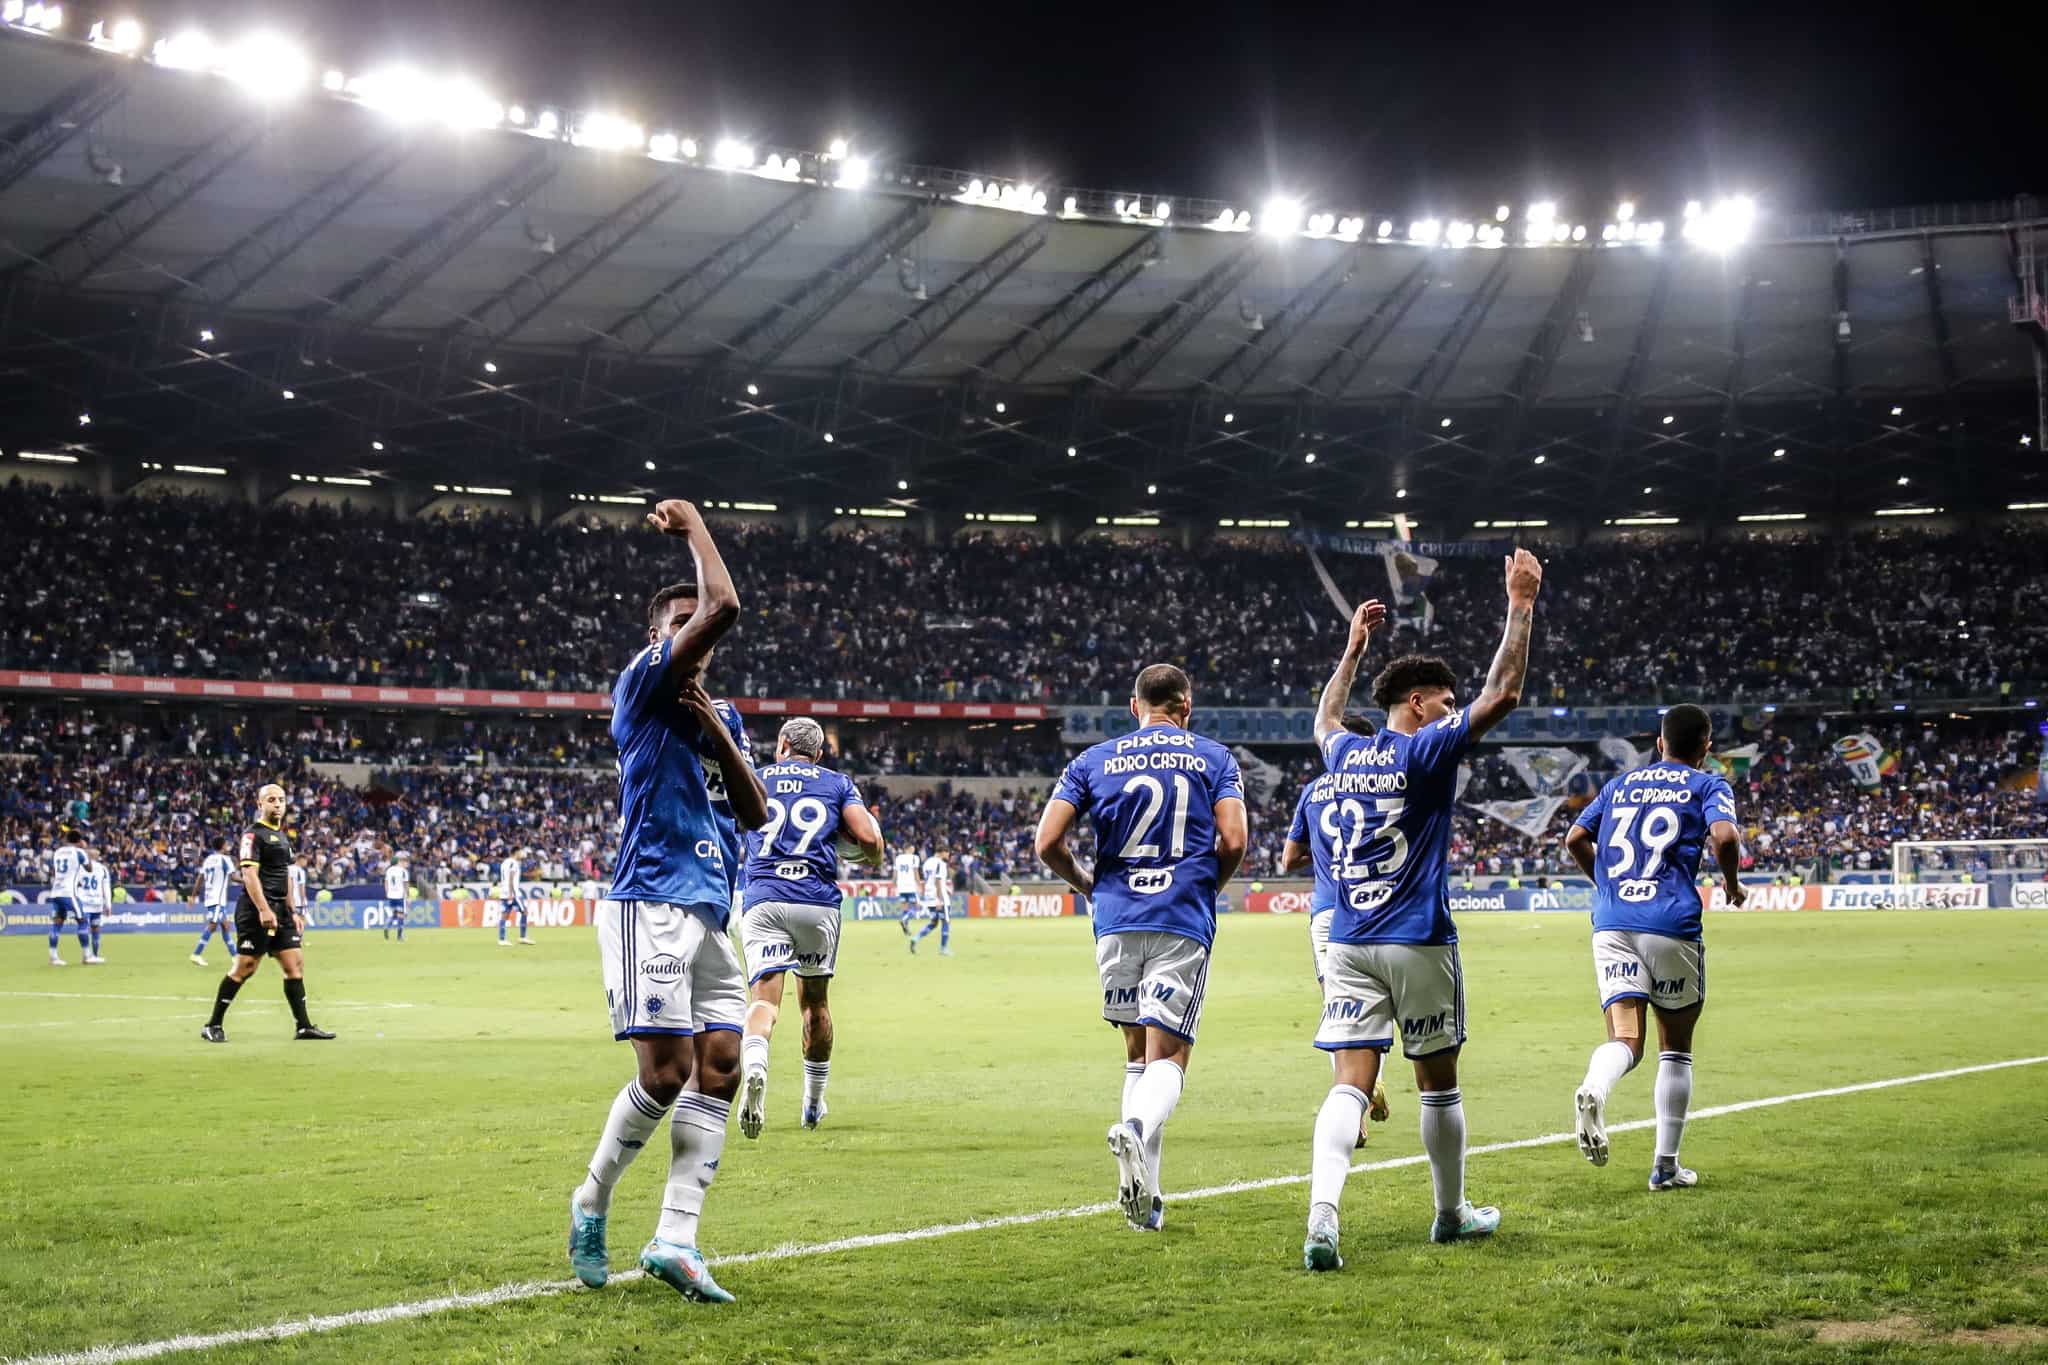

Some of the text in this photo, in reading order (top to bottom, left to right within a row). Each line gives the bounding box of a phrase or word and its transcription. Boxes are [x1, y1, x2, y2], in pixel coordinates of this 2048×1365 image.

[1117, 730, 1195, 753] pixbet
[763, 764, 820, 779] pixbet
[1104, 752, 1207, 775] PEDRO CASTRO
[776, 779, 803, 793] EDU
[1624, 767, 1690, 785] pixbet
[1612, 790, 1626, 804] M.
[1118, 774, 1190, 858] 21
[1340, 797, 1409, 878] 23
[1607, 806, 1679, 879] 39
[1134, 873, 1166, 888] BH
[1354, 889, 1389, 904] BH
[1624, 886, 1651, 897] BH
[1709, 886, 1805, 912] BTANO
[996, 895, 1062, 917] BETANO
